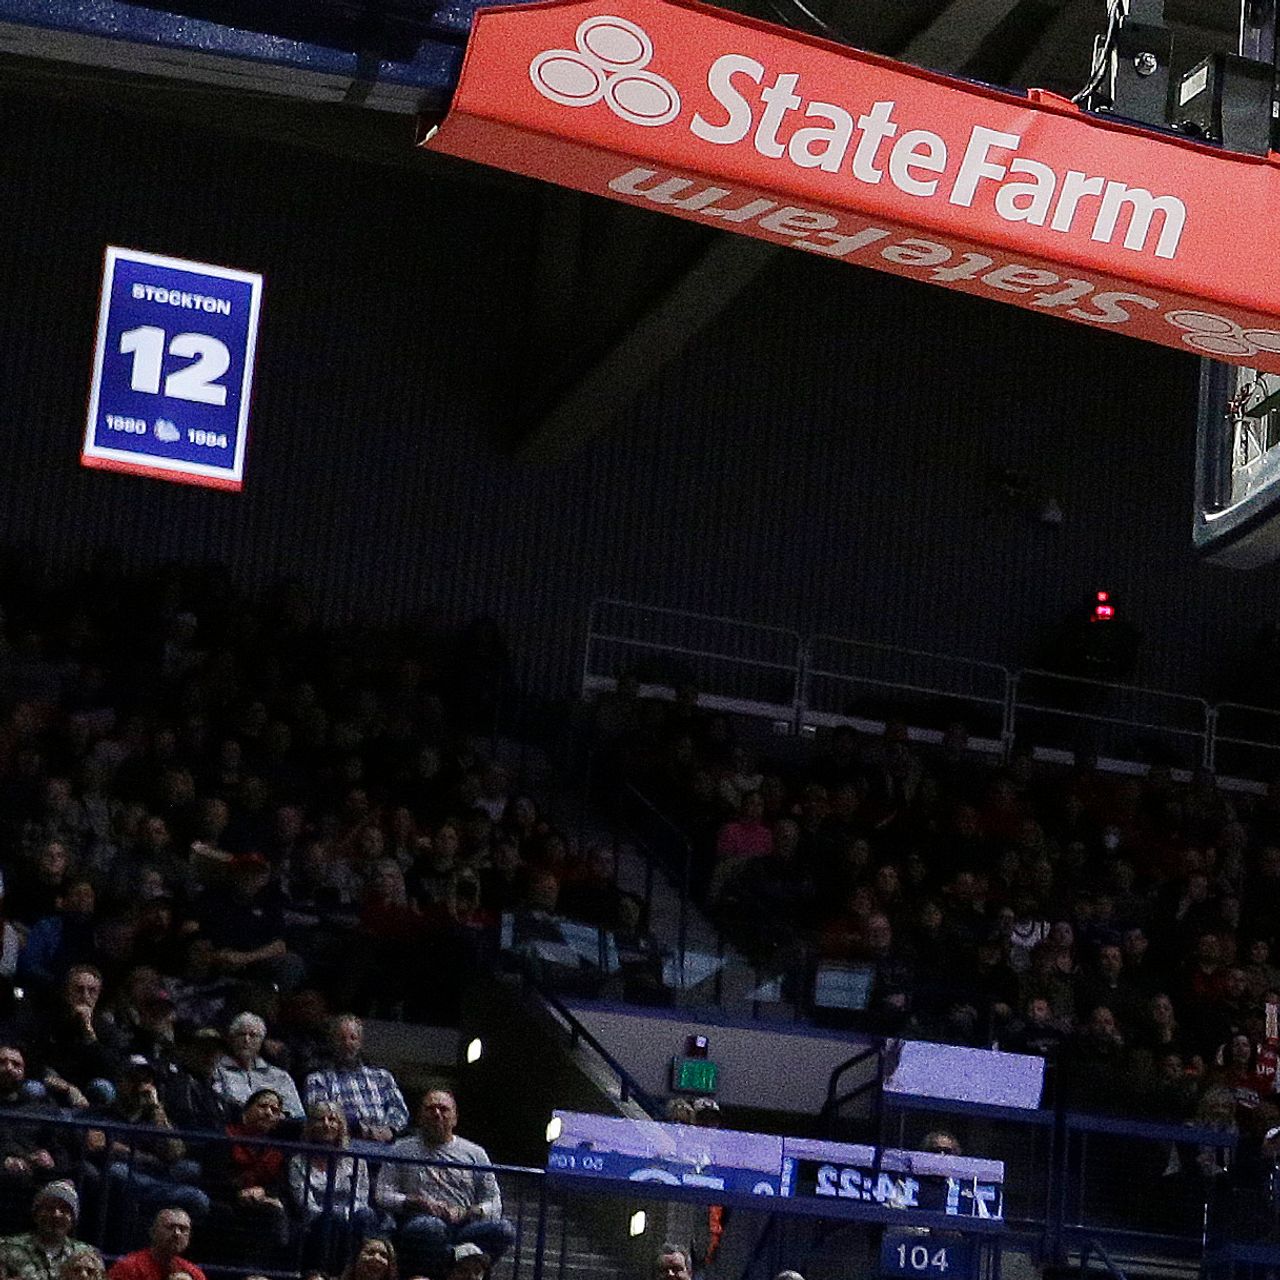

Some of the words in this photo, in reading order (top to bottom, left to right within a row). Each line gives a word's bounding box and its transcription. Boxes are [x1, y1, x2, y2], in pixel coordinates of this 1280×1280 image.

[132, 283, 231, 316] STOCKTON
[120, 325, 230, 406] 12
[898, 1244, 949, 1272] 104
